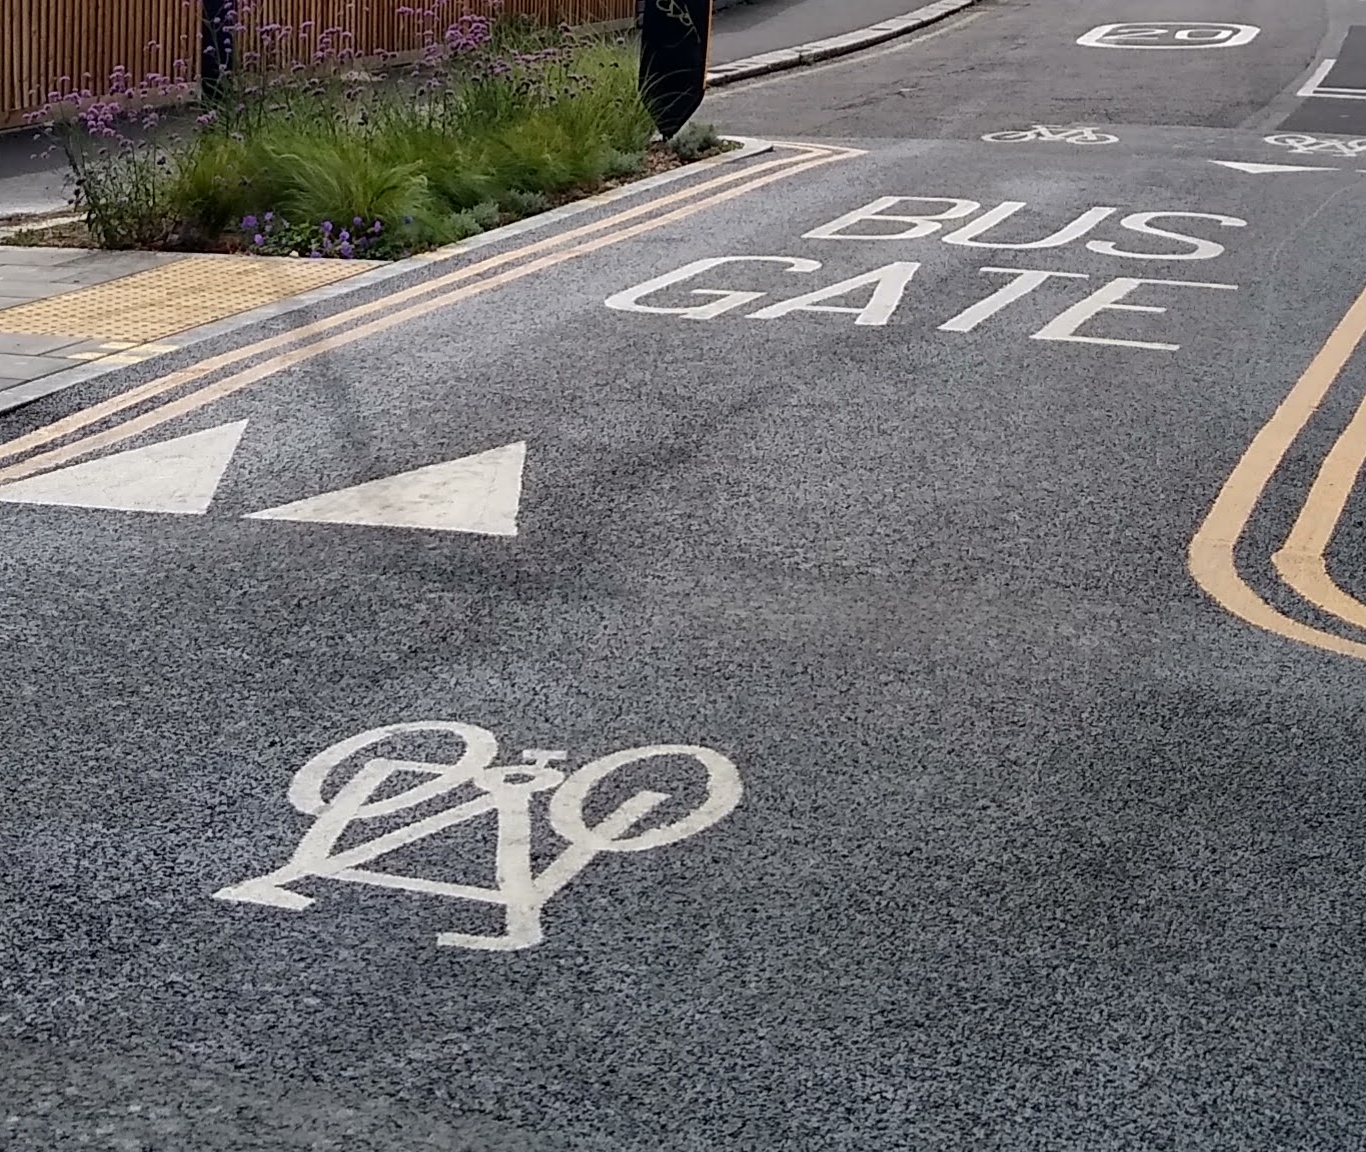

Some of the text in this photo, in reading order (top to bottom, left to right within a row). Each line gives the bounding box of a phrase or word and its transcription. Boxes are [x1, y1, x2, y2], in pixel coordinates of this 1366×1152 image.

[1101, 28, 1234, 41] 20
[801, 195, 1248, 260] BUS
[604, 255, 1239, 350] GATE
